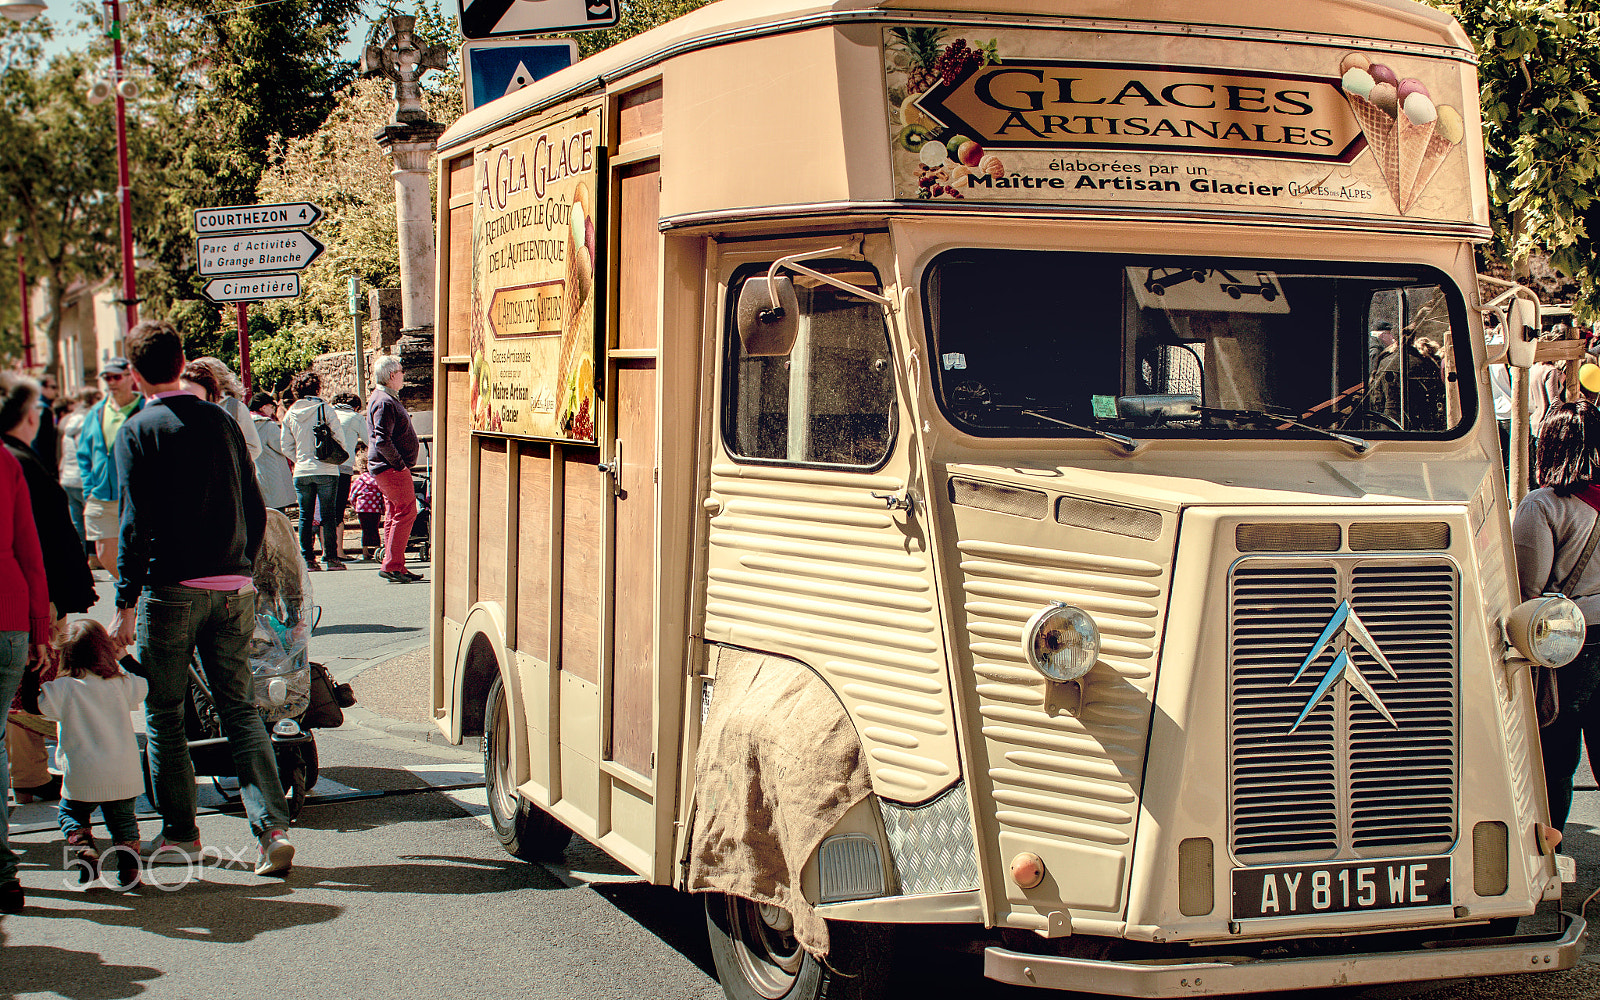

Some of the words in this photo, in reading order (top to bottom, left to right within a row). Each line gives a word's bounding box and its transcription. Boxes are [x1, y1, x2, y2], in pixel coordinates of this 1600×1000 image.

[974, 68, 1314, 116] GLACES
[993, 111, 1334, 147] ARTISANALES
[480, 159, 495, 210] A
[496, 149, 529, 209] GLA
[534, 130, 593, 199] GLACE
[1049, 158, 1142, 174] élaborées
[1149, 162, 1179, 175] par
[1186, 166, 1208, 175] un
[967, 173, 1065, 190] Maître
[1074, 175, 1181, 192] Artisan
[1190, 178, 1284, 197] Glacier
[1288, 181, 1330, 197] GLACES
[1340, 186, 1372, 199] ALPES
[200, 210, 288, 227] COURTHEZON
[299, 208, 307, 220] 4
[485, 205, 532, 246] RETROUVEZ
[534, 204, 544, 225] LE
[545, 194, 571, 231] GOÛT
[202, 244, 227, 253] Parc
[203, 258, 213, 268] la
[217, 257, 254, 267] Grange
[259, 253, 301, 264] Blanche
[489, 252, 500, 273] DE
[223, 281, 293, 294] Cimetière
[1261, 872, 1302, 913] AY
[1312, 867, 1376, 910] 815
[1387, 863, 1428, 904] WE
